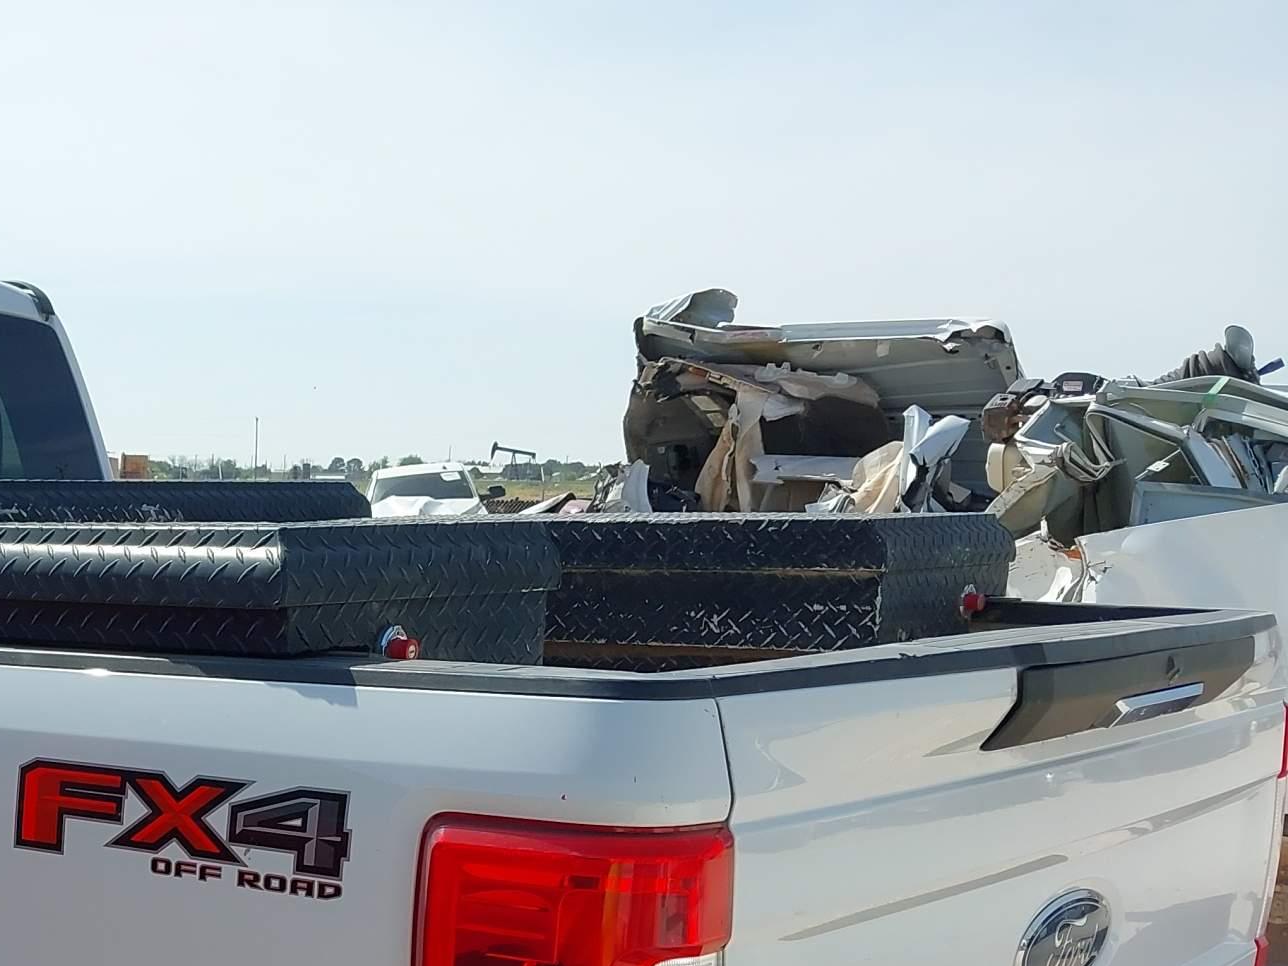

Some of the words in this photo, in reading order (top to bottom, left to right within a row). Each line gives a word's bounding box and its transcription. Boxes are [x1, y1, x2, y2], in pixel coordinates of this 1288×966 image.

[13, 757, 352, 881] FX4
[150, 856, 222, 881] OFF
[237, 868, 343, 900] ROAD
